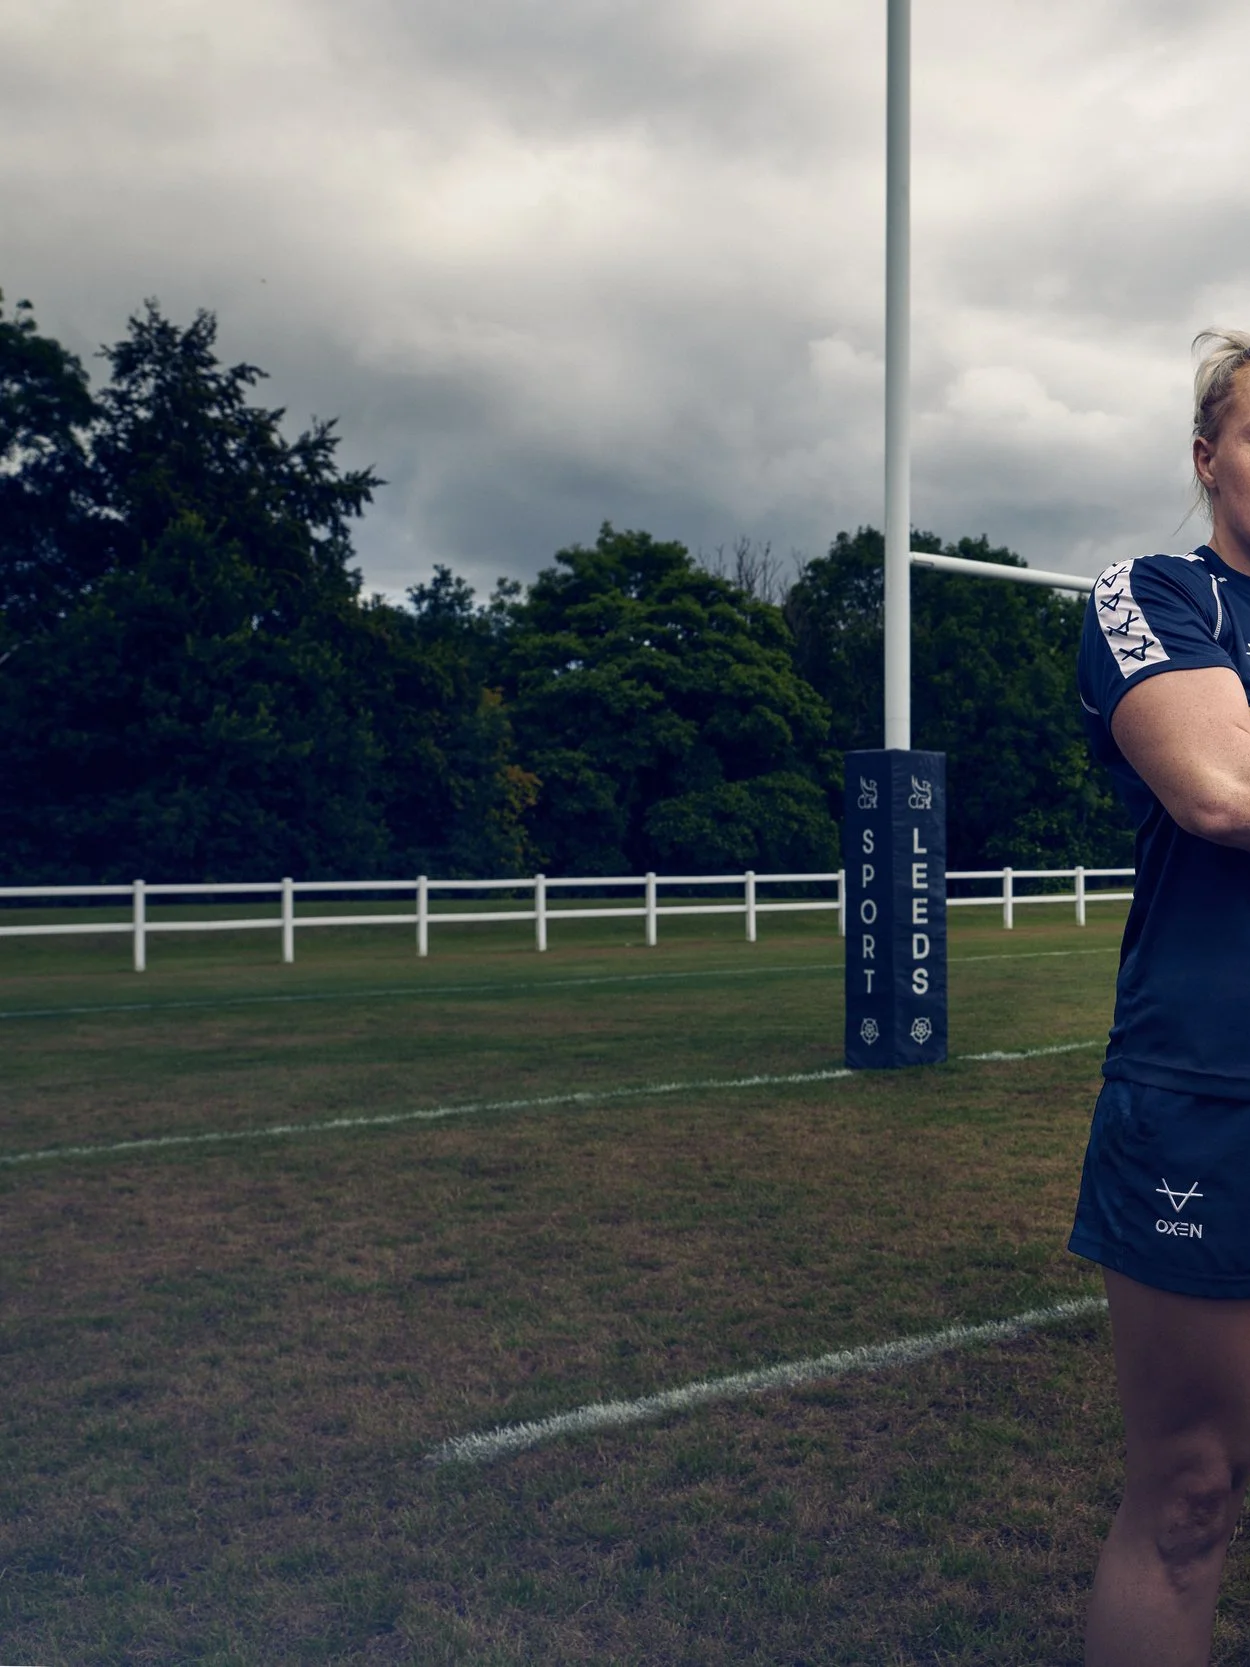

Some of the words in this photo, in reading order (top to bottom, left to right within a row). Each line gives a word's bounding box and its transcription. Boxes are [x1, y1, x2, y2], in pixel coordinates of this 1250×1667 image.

[859, 828, 878, 994] SPORT
[911, 827, 931, 995] LEEDS
[1155, 1218, 1203, 1239] OXEN
